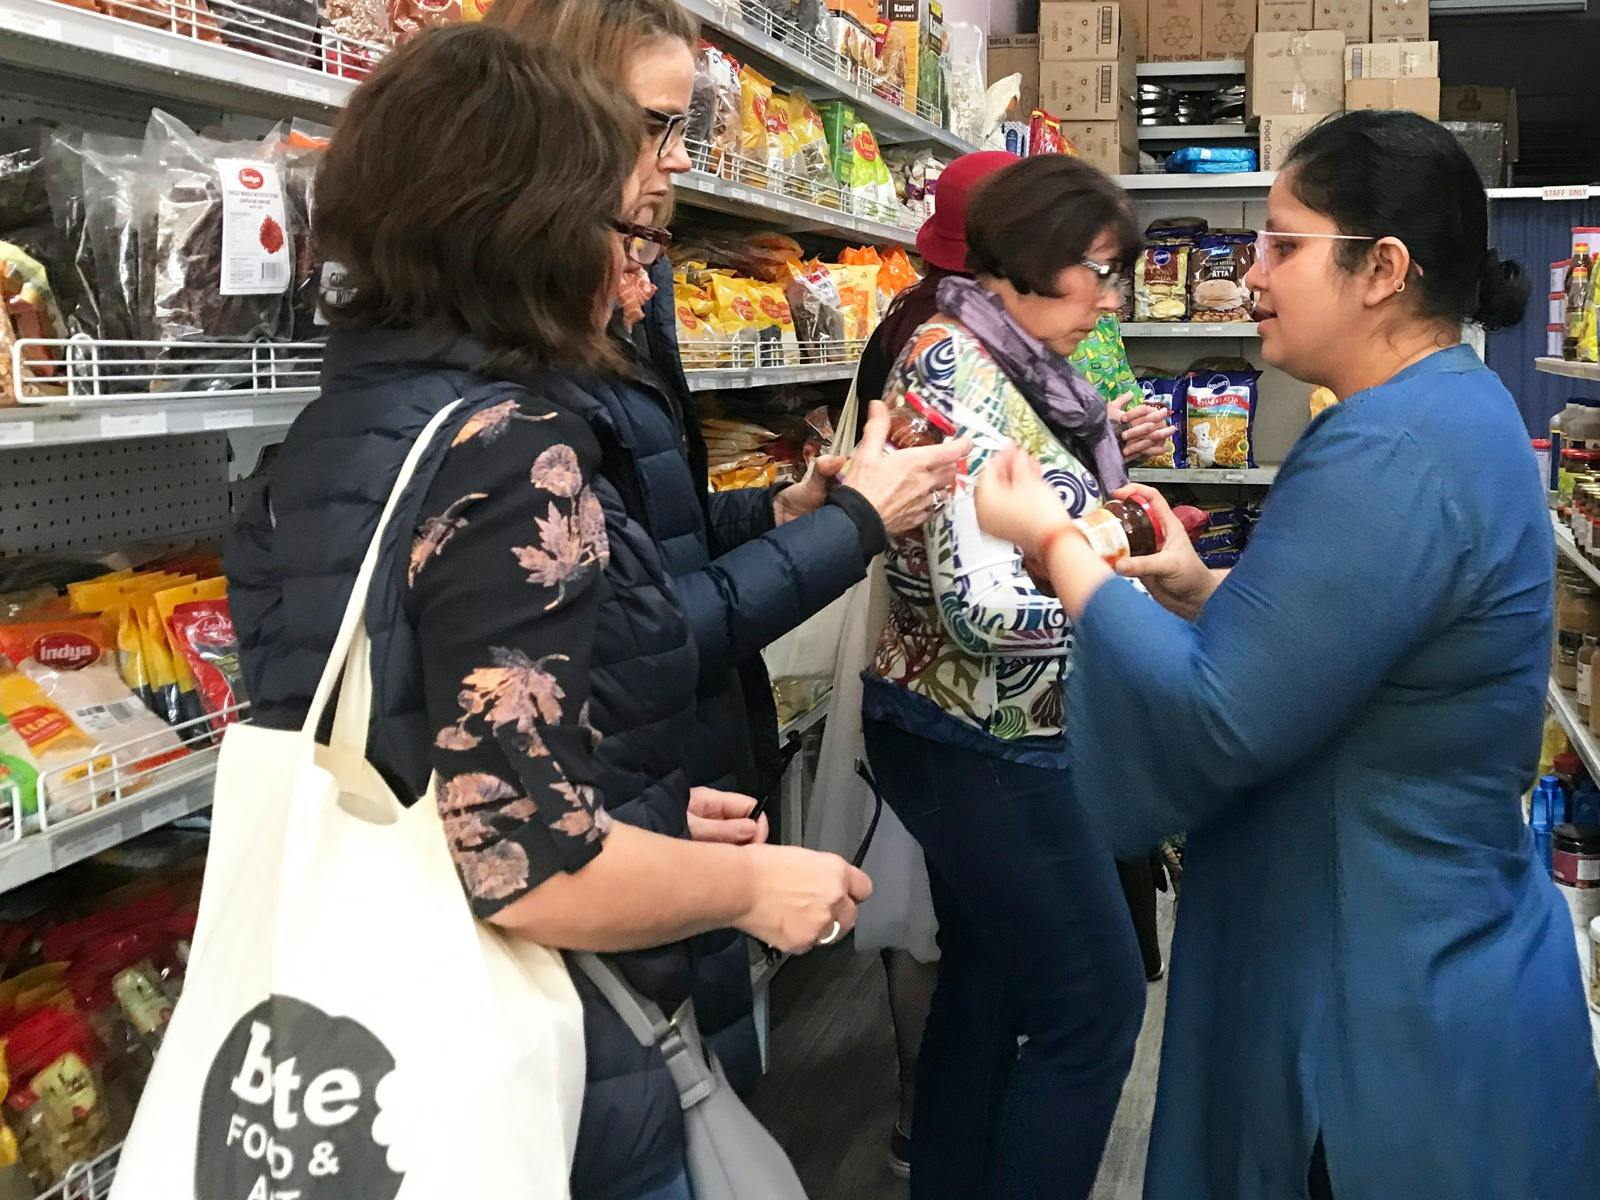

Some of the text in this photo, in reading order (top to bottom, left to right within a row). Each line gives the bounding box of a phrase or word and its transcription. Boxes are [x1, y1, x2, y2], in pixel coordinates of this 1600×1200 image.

[894, 3, 914, 12] Kasuri
[1263, 119, 1273, 171] Food Grade
[1544, 189, 1565, 197] STAFF
[1212, 270, 1229, 278] ATTA
[230, 1020, 361, 1130] bte
[307, 1140, 340, 1177] &
